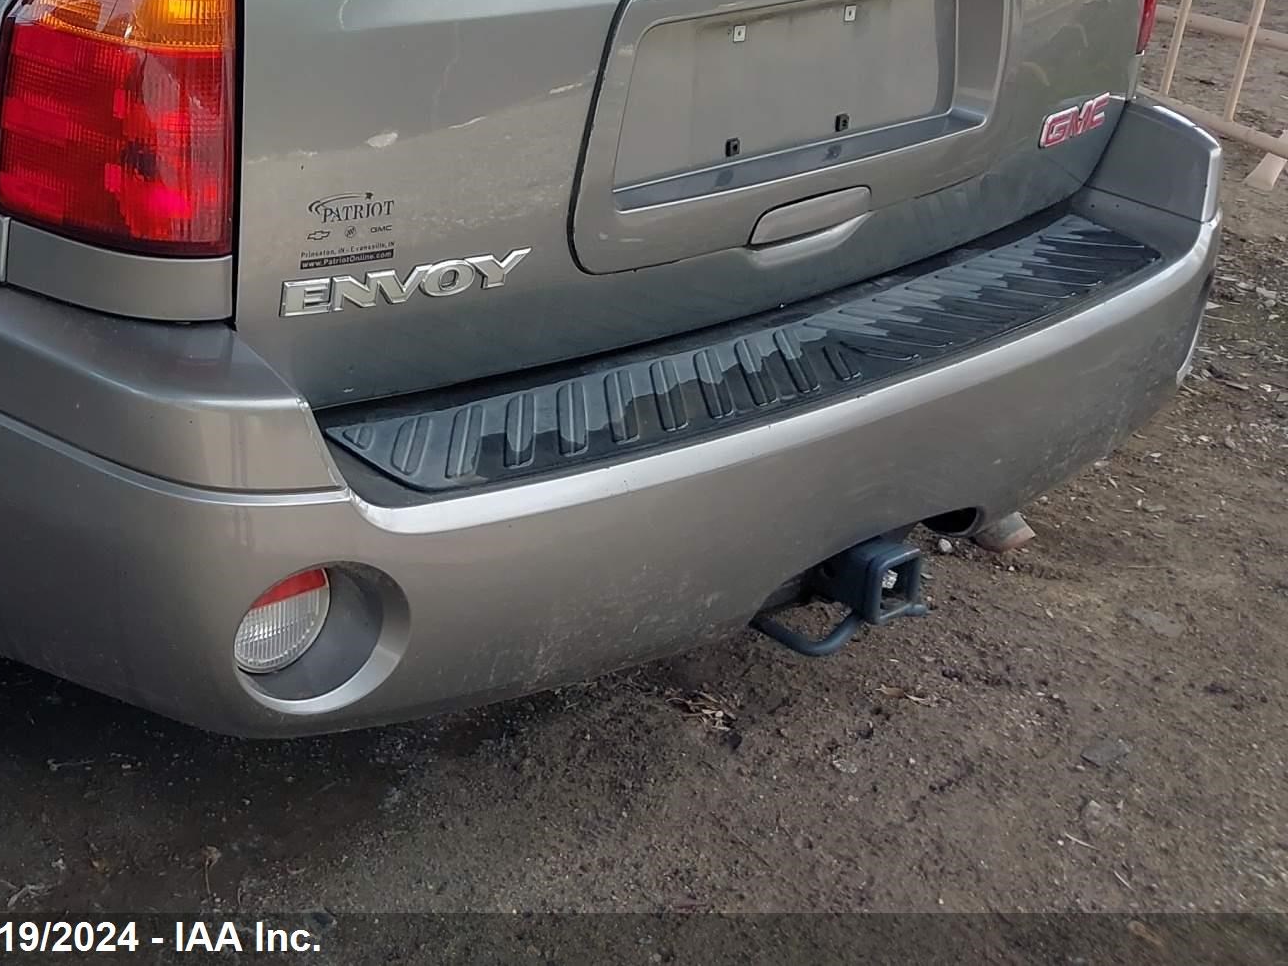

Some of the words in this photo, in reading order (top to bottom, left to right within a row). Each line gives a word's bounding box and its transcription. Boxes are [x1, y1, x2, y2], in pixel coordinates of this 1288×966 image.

[1039, 92, 1110, 149] GMC
[320, 200, 395, 224] PATRIOT
[370, 225, 393, 234] GMC
[301, 250, 393, 269] www.PatriotOnline.com
[279, 246, 532, 317] ENVOY
